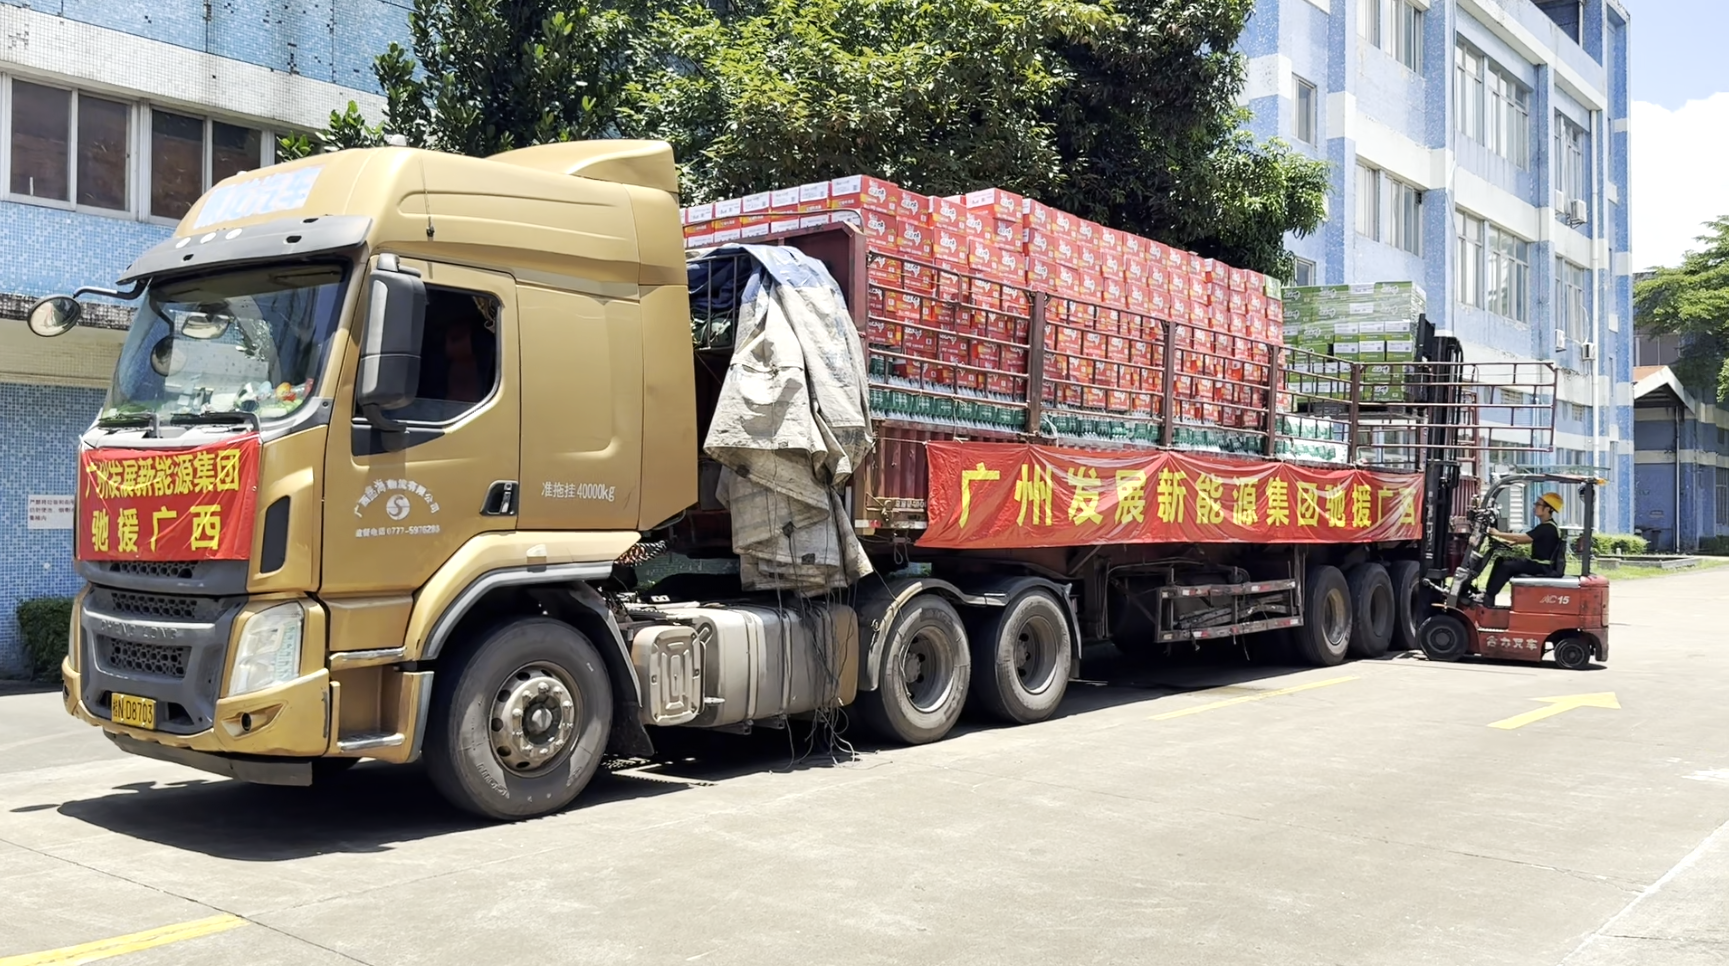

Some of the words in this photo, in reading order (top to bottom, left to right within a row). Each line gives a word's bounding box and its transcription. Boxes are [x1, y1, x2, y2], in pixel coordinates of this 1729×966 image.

[85, 449, 241, 499] 广州发展新能源集团
[91, 505, 222, 553] 驰援广西
